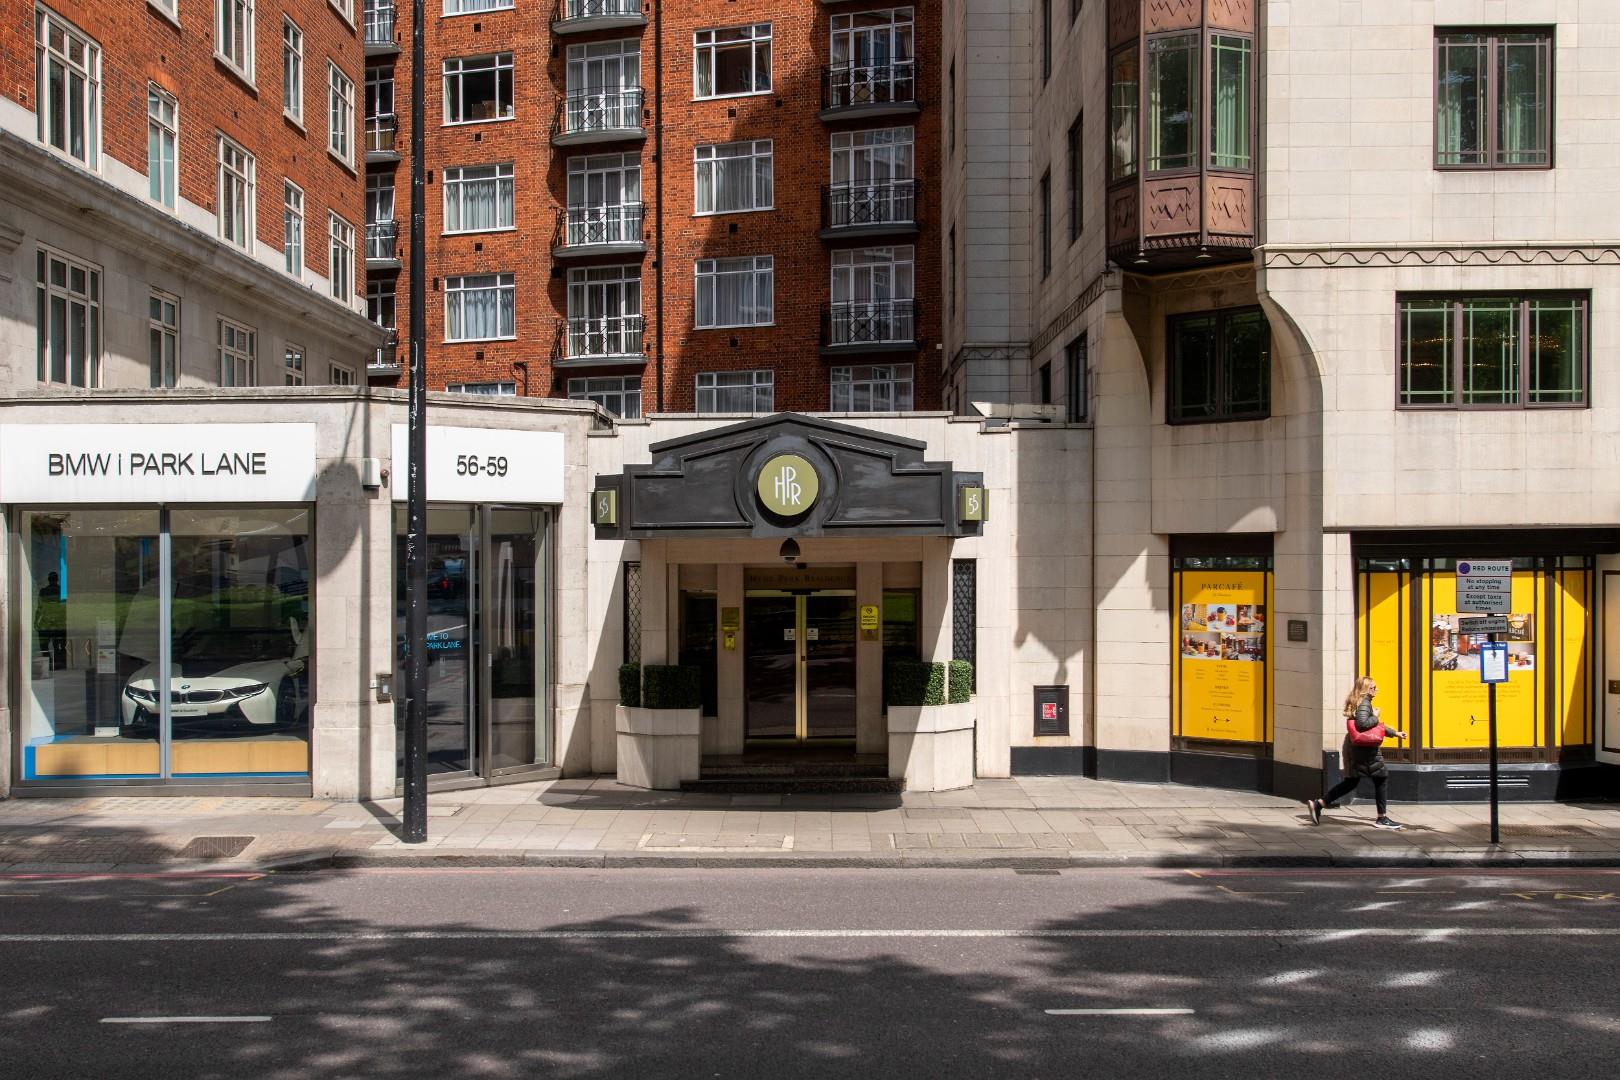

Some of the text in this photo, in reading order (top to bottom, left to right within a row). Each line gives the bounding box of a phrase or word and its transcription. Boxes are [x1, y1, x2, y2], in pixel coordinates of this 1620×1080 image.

[48, 453, 111, 476] BMW
[130, 453, 195, 476] PARK
[201, 453, 267, 476] LANE
[456, 454, 508, 478] 56-59
[774, 466, 802, 506] HPR
[967, 494, 979, 515] 55
[1201, 581, 1244, 591] PARCAFÉ
